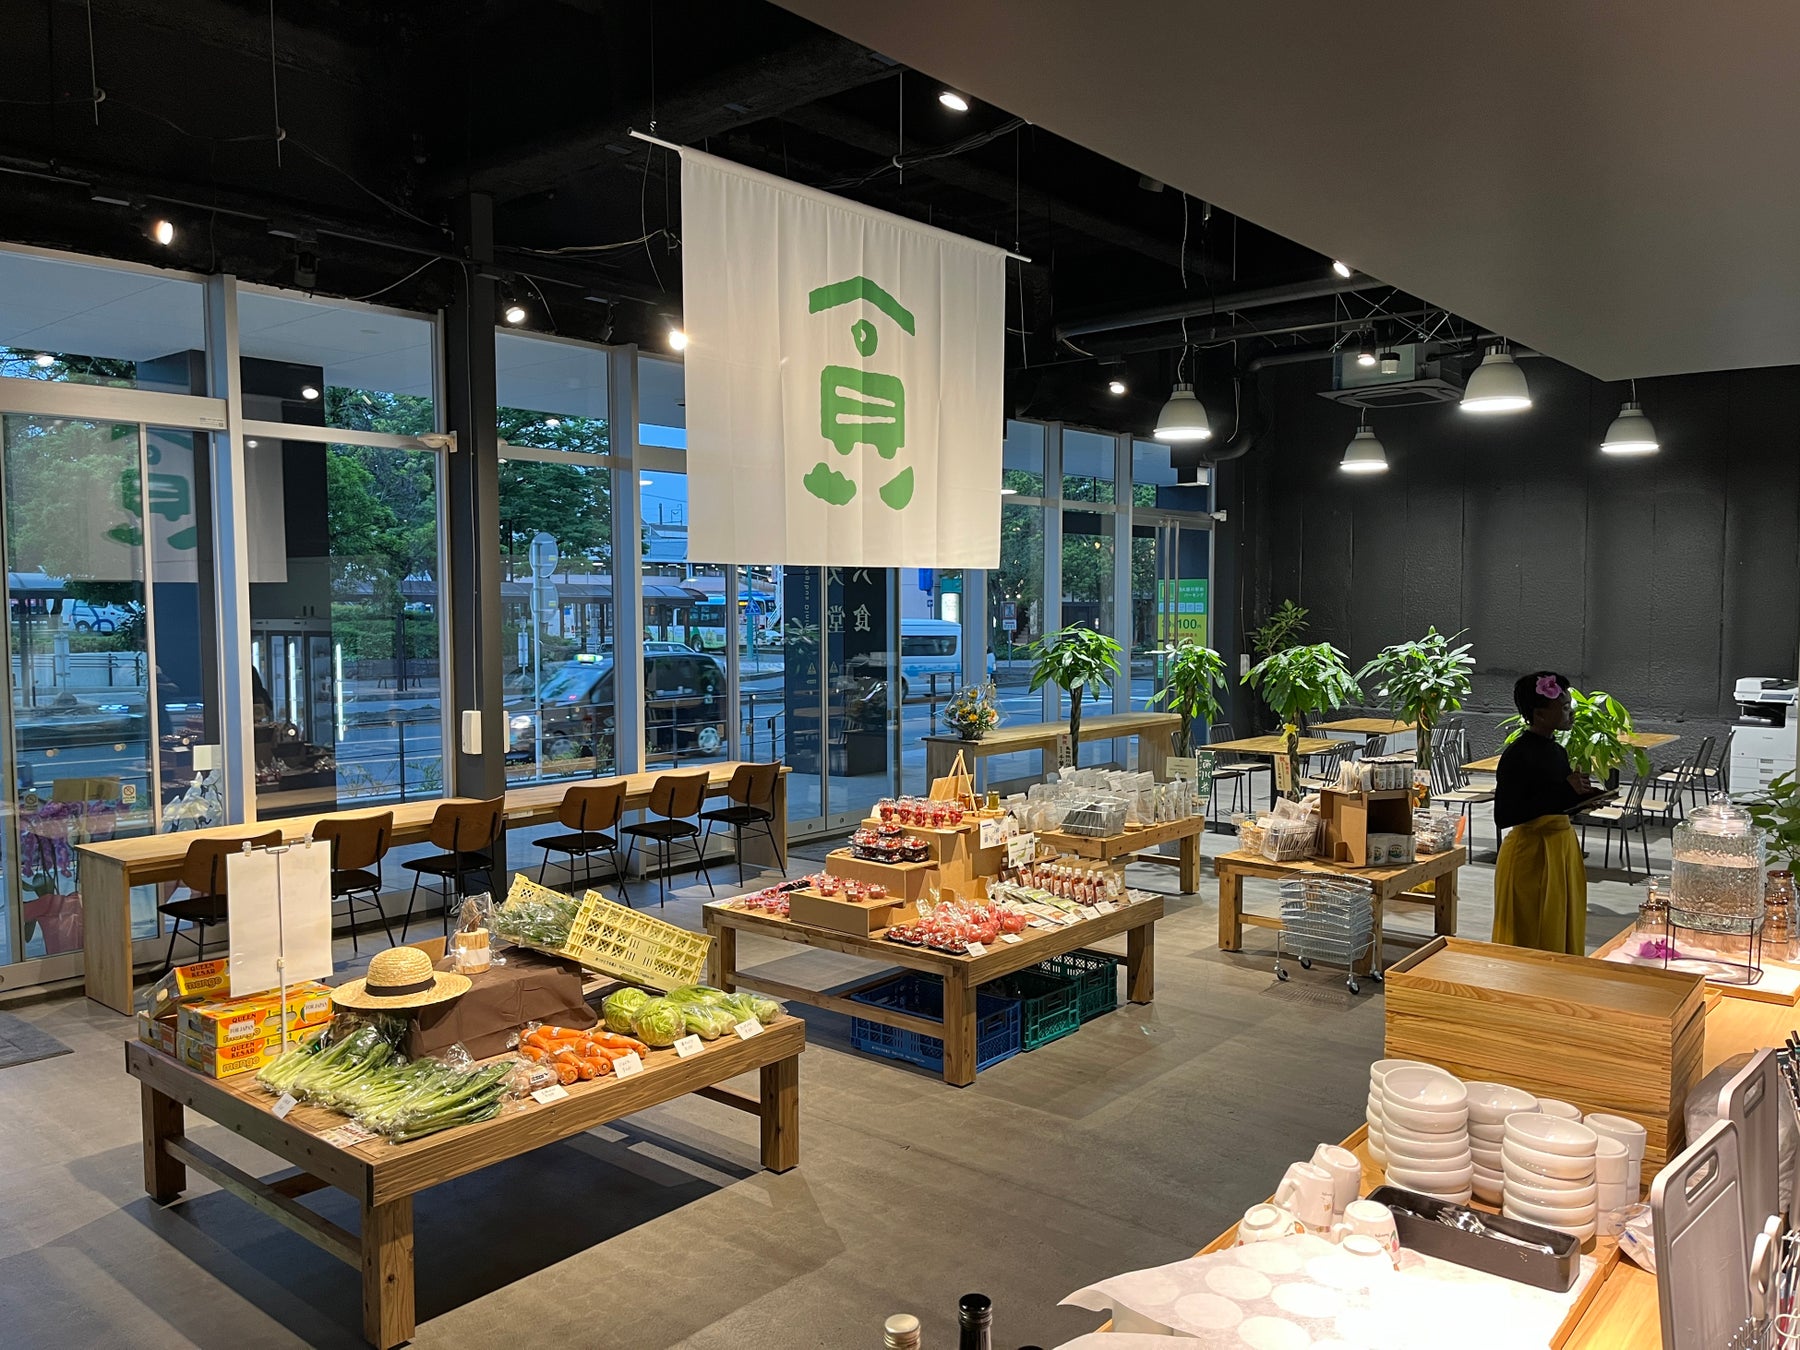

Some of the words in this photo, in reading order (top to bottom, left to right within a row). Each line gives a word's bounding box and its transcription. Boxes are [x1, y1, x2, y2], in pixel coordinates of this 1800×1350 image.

[190, 962, 215, 972] QUEEN
[191, 968, 216, 978] KESAR
[185, 976, 223, 990] mango
[306, 1003, 316, 1011] FOR
[316, 1001, 328, 1010] JAPAN
[232, 1013, 257, 1024] QUEEN
[229, 1026, 240, 1035] FOR
[240, 1024, 254, 1034] JAPAN
[231, 1042, 255, 1053] QUEEN
[231, 1048, 255, 1059] KESAR
[222, 1056, 260, 1073] mango
